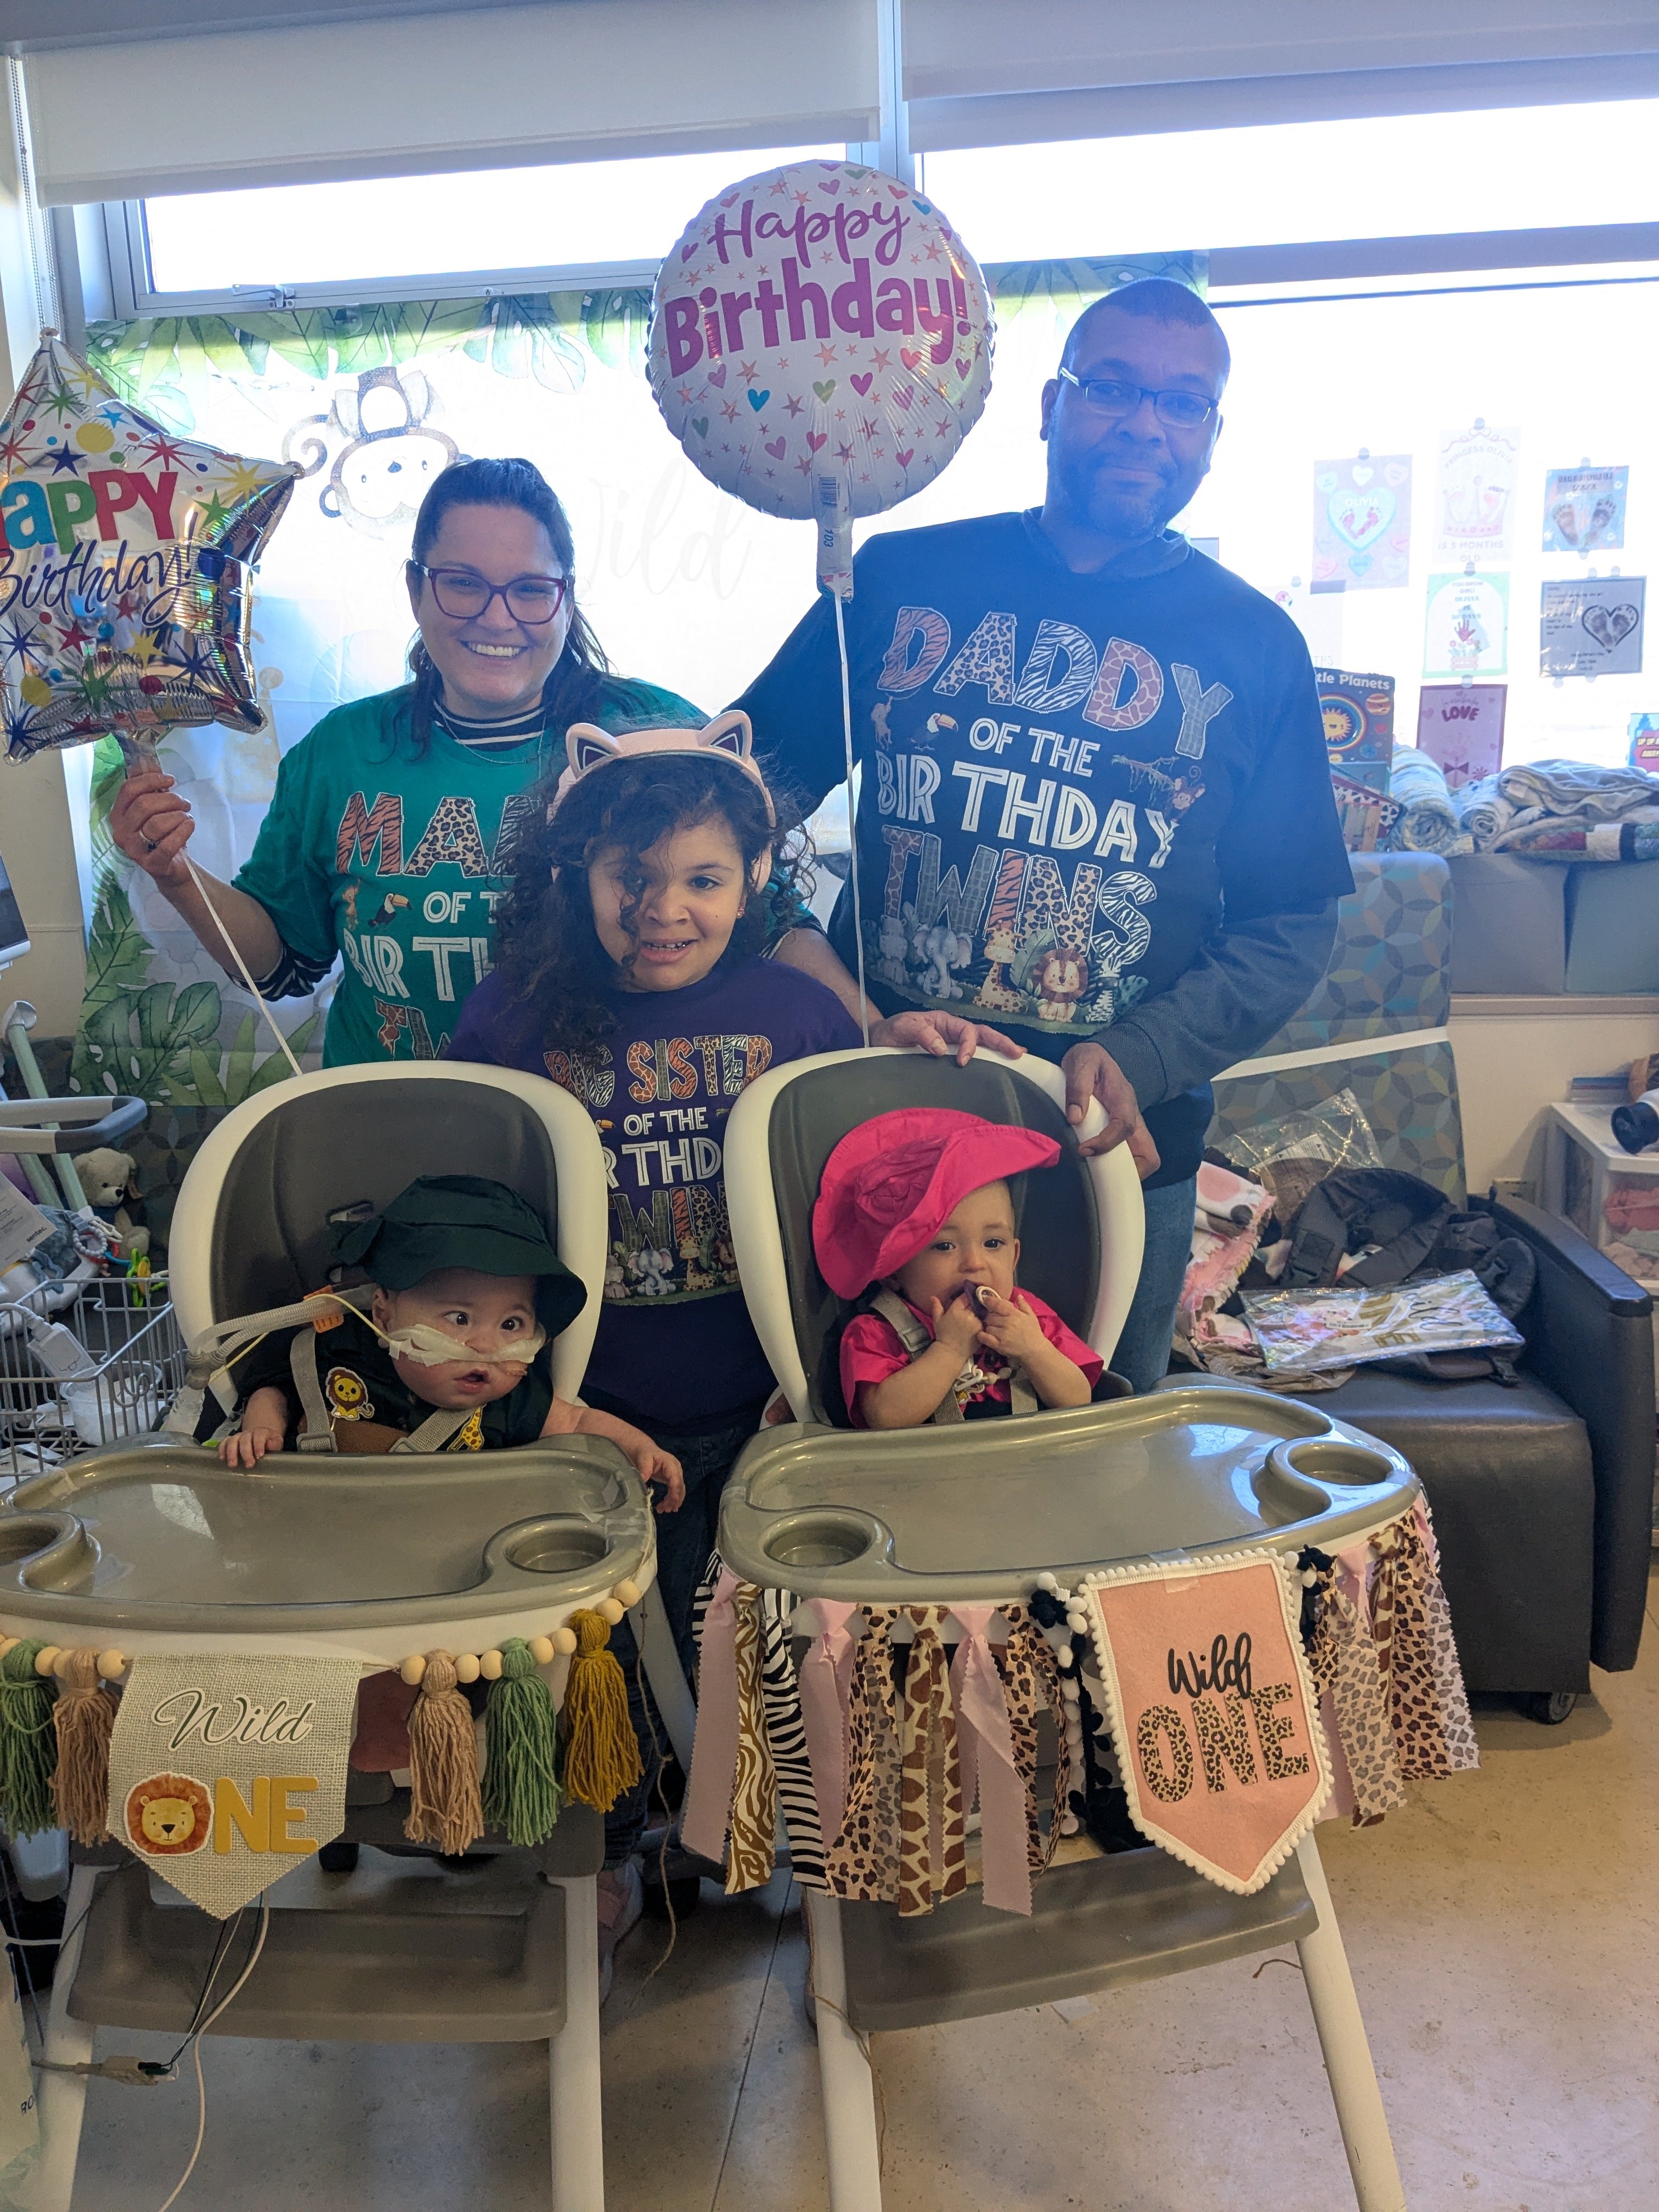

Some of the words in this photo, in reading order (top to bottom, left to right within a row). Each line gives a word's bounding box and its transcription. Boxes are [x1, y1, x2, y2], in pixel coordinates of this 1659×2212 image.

[707, 199, 911, 269] Happy
[664, 257, 972, 378] Birthday!
[1487, 446, 1513, 465] OLIVIA
[1345, 497, 1379, 507] OLIVIA
[823, 528, 834, 548] 103
[1459, 540, 1504, 549] MONTHS
[1460, 554, 1481, 562] OLD
[878, 607, 1234, 759] DADDY
[1316, 672, 1335, 684] tle
[1339, 674, 1390, 691] Planets
[1441, 706, 1480, 722] LOVE
[969, 718, 1020, 755] OF
[1028, 727, 1101, 777] THE
[336, 791, 531, 878] MA
[423, 890, 471, 924] OF
[881, 825, 1158, 966] TWINS
[624, 1113, 654, 1136] OF
[660, 1107, 708, 1132] THE
[1167, 1632, 1252, 1700] Wild
[153, 1688, 315, 1750] Wild
[1137, 1681, 1310, 1802] ONE
